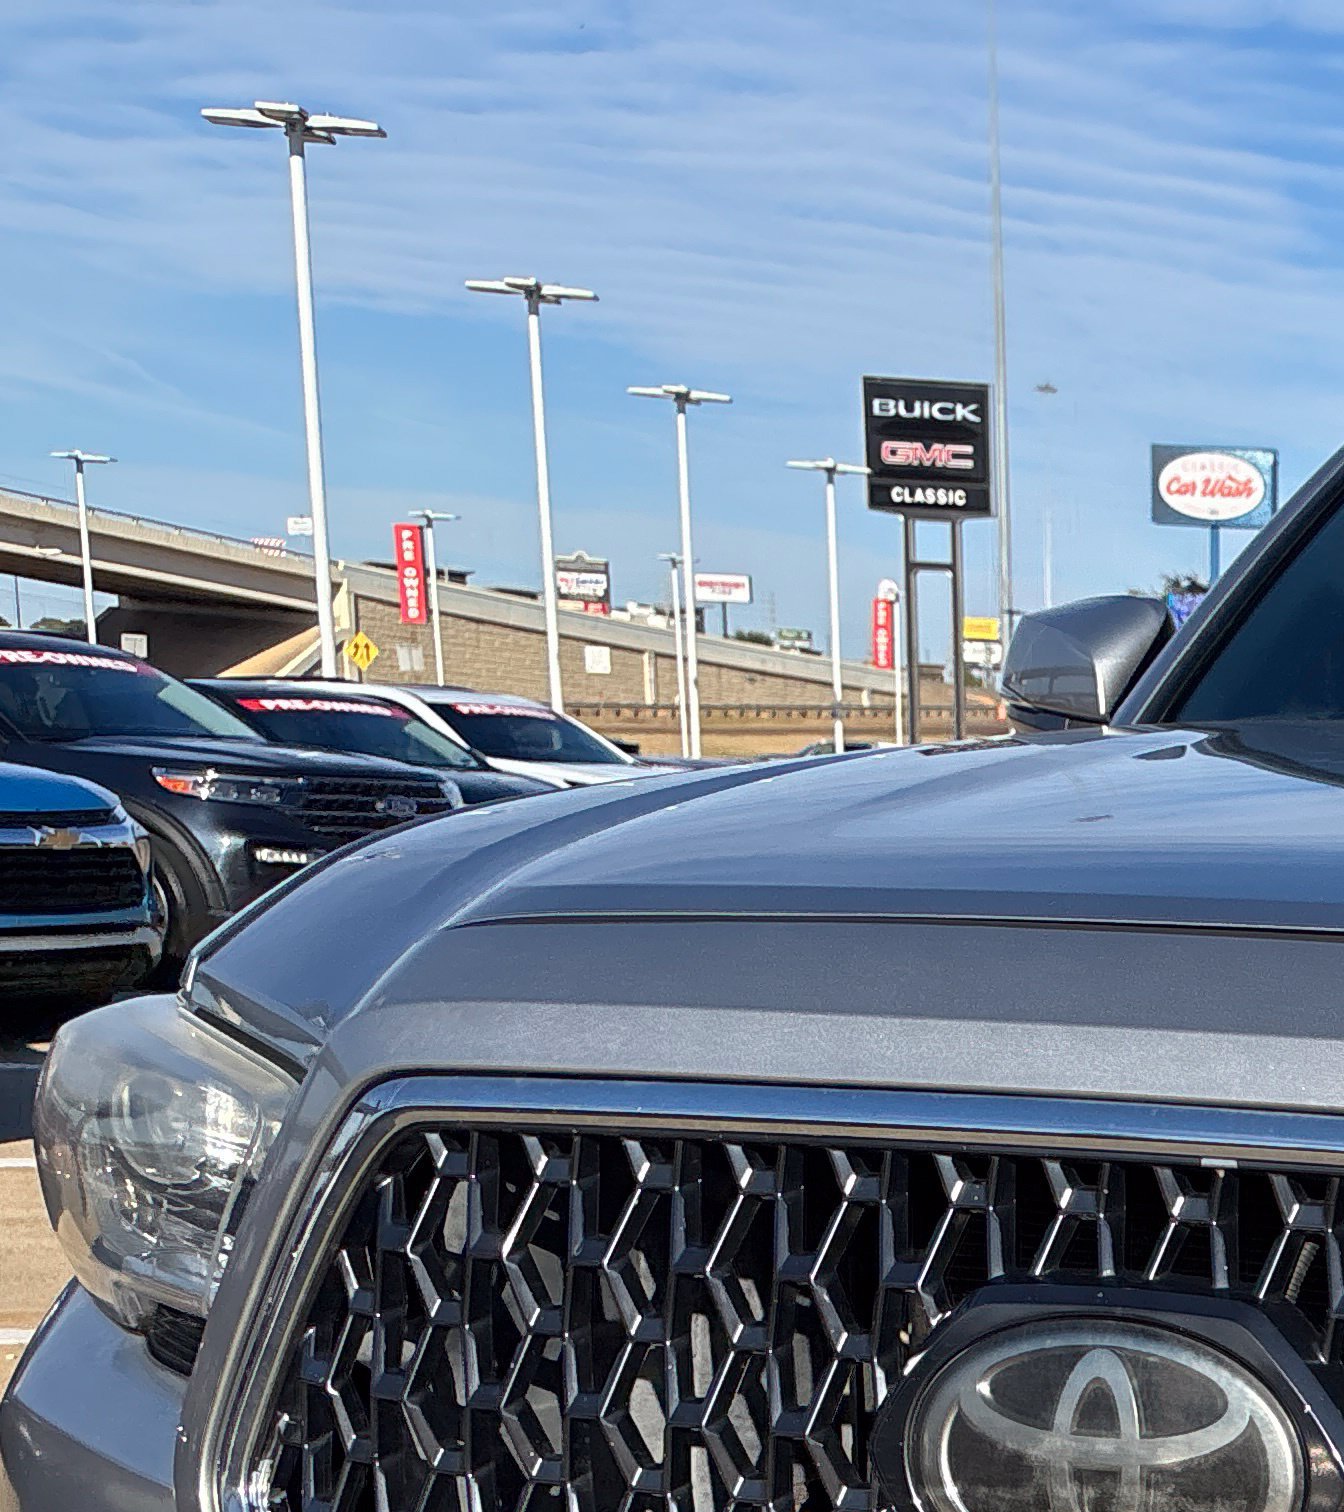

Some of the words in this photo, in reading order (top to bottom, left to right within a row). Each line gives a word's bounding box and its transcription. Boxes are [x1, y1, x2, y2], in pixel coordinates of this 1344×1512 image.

[872, 398, 981, 422] BUICK
[881, 441, 974, 469] GMC
[891, 486, 966, 506] CLASSIC
[1166, 476, 1197, 496] Car
[1201, 474, 1257, 498] Wash
[401, 529, 415, 561] PRE
[403, 567, 419, 618] OWNED
